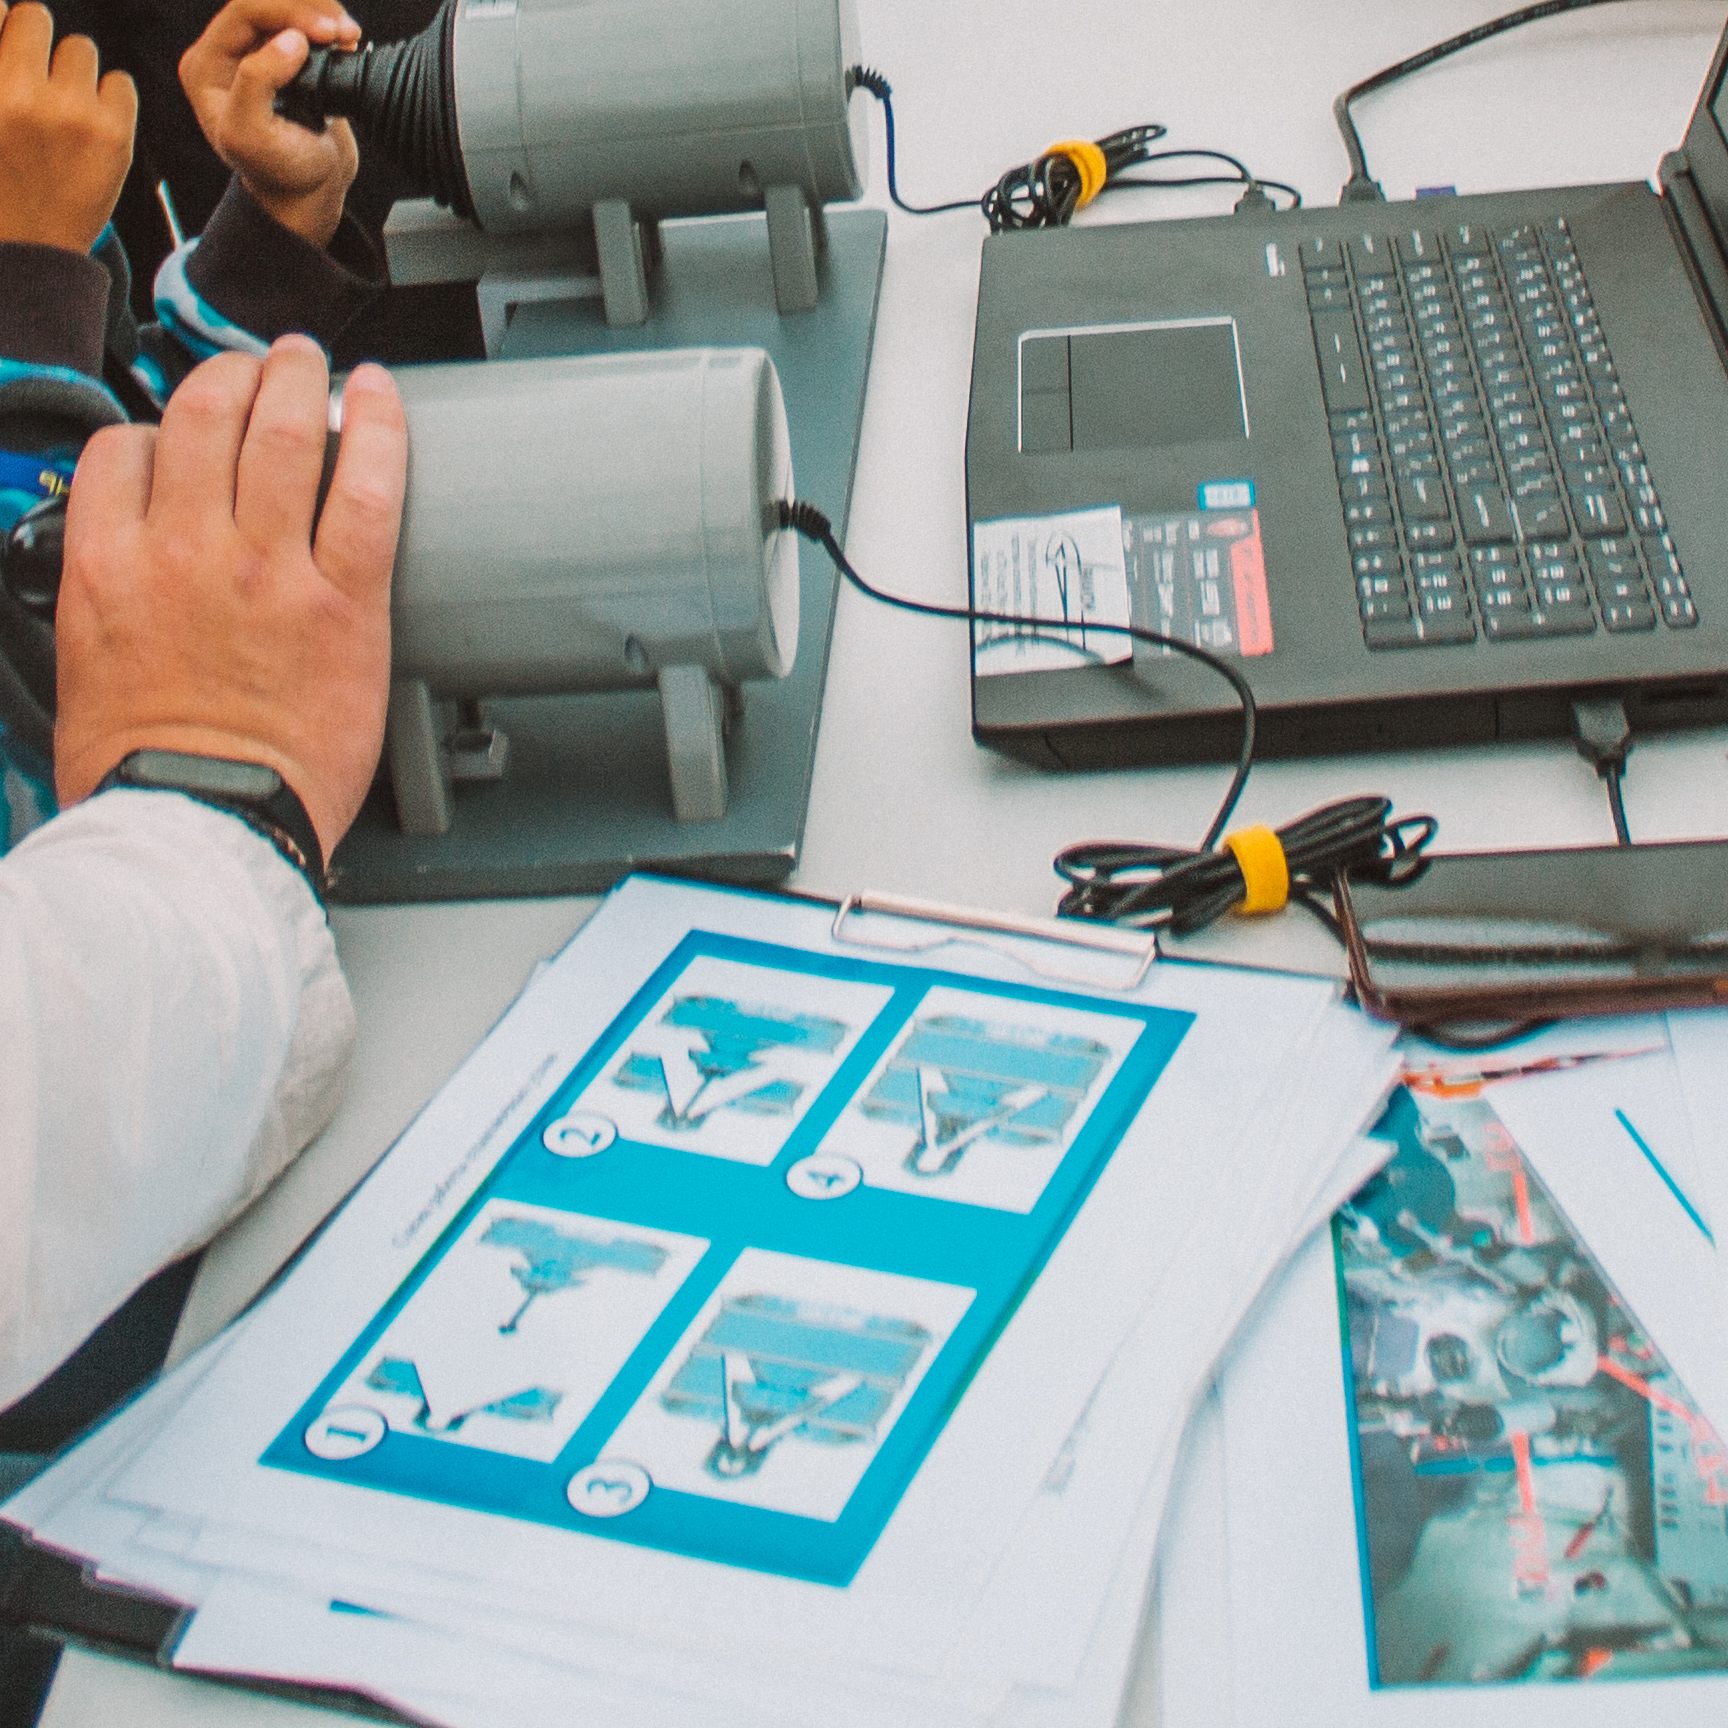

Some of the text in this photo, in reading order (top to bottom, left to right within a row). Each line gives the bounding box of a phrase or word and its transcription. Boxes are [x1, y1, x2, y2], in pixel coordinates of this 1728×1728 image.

[559, 1127, 601, 1147] 2
[806, 1170, 843, 1189] 4
[326, 1425, 368, 1442] 1
[586, 1476, 633, 1504] 3
